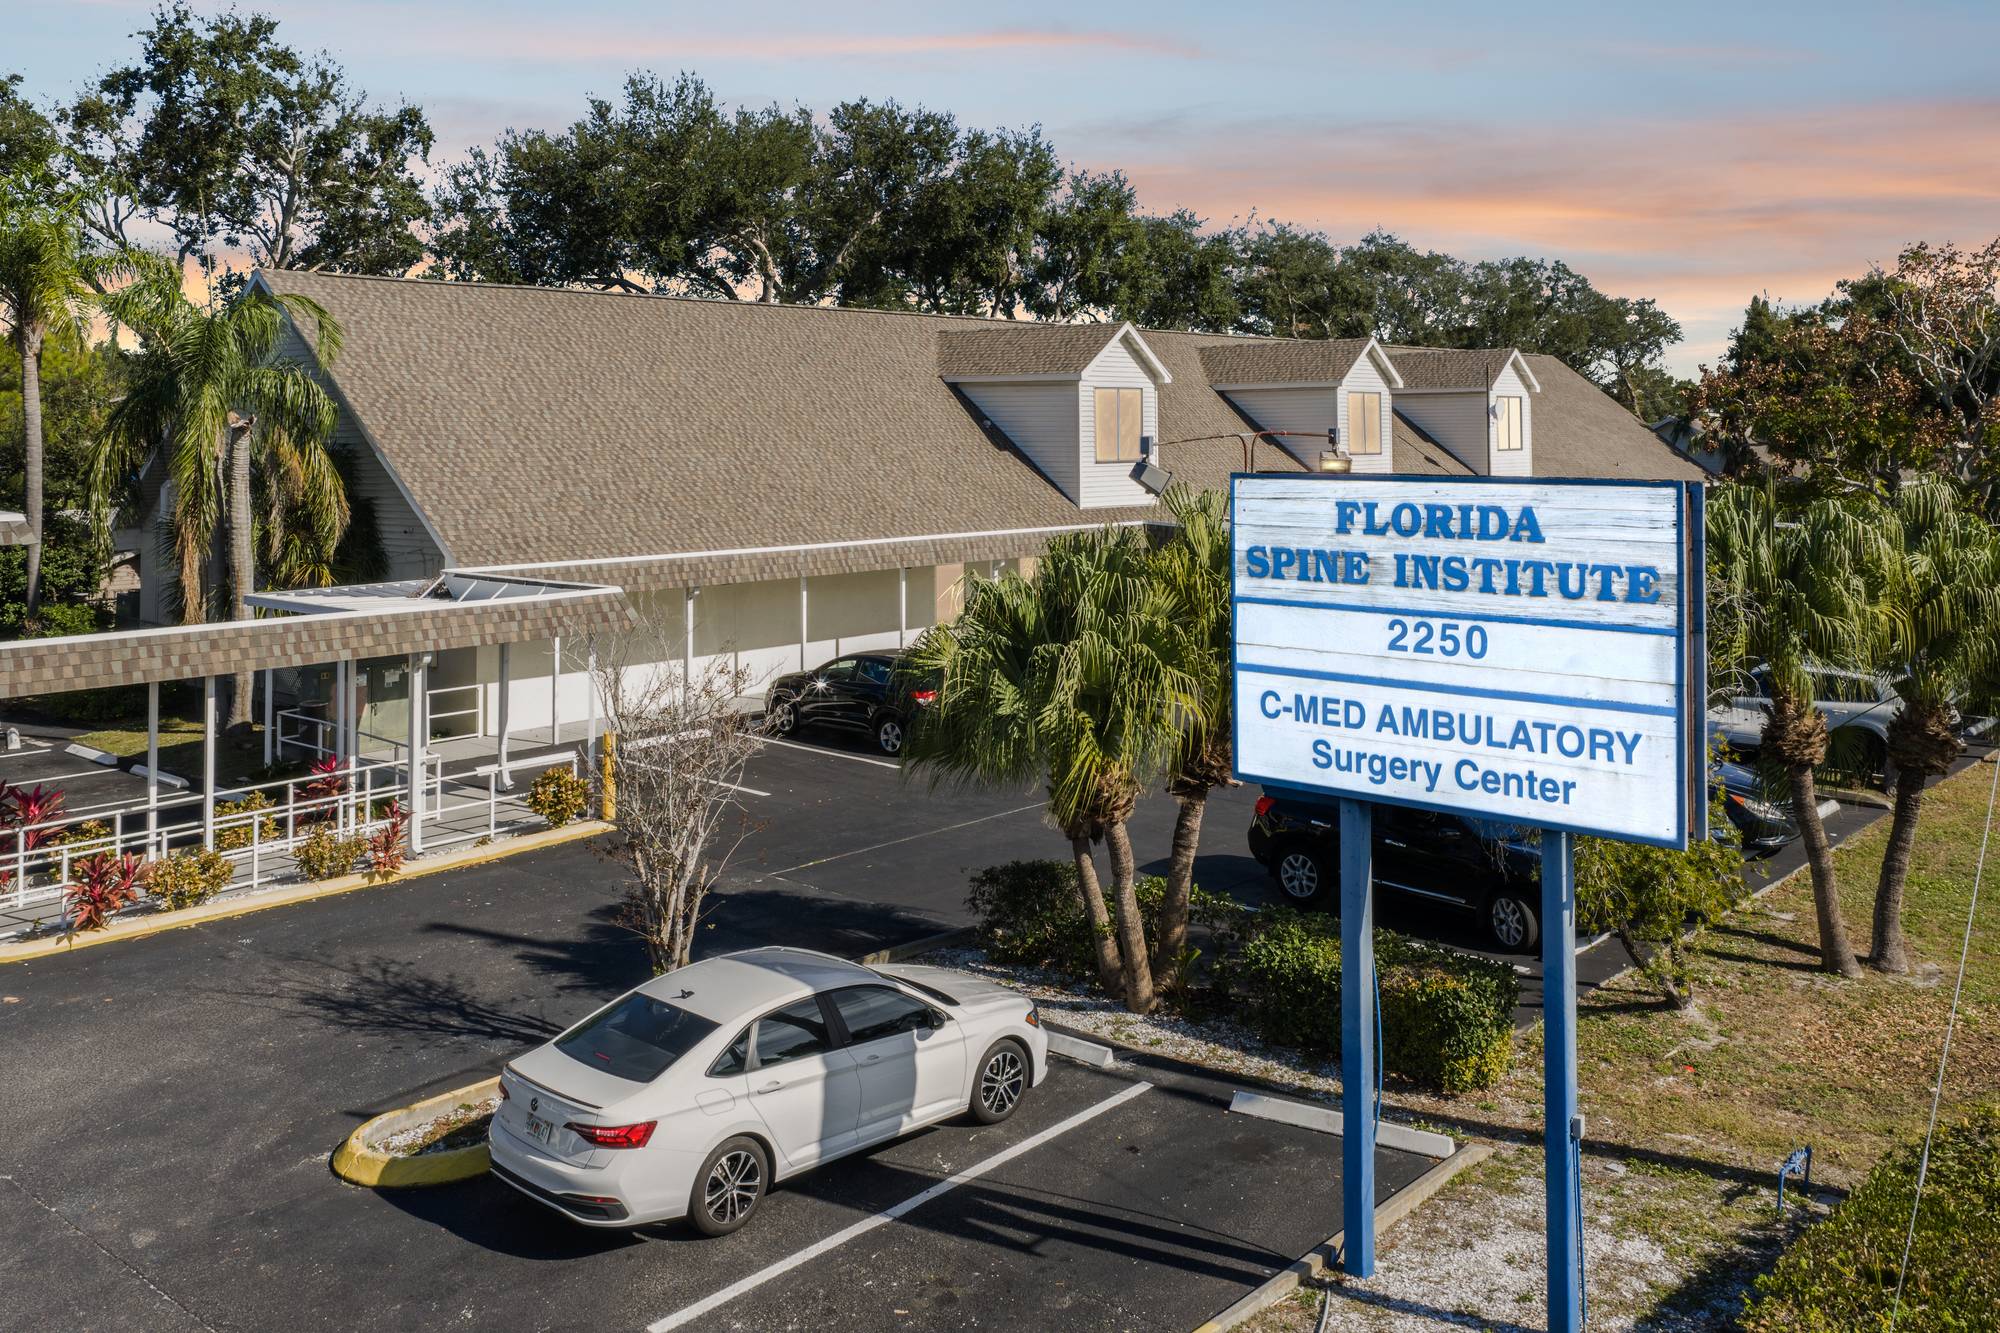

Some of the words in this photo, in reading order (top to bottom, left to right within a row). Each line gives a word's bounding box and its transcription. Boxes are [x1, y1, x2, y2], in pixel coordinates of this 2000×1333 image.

[1335, 501, 1545, 543] FLORIDA
[1246, 546, 1370, 585] SPINE
[1393, 554, 1661, 603] INSTITUTE
[1387, 619, 1489, 660] 2250
[1259, 690, 1366, 730] C-MED
[1375, 705, 1641, 765] AMBULATORY
[1311, 740, 1442, 792] Surgery
[1455, 760, 1577, 804] Center
